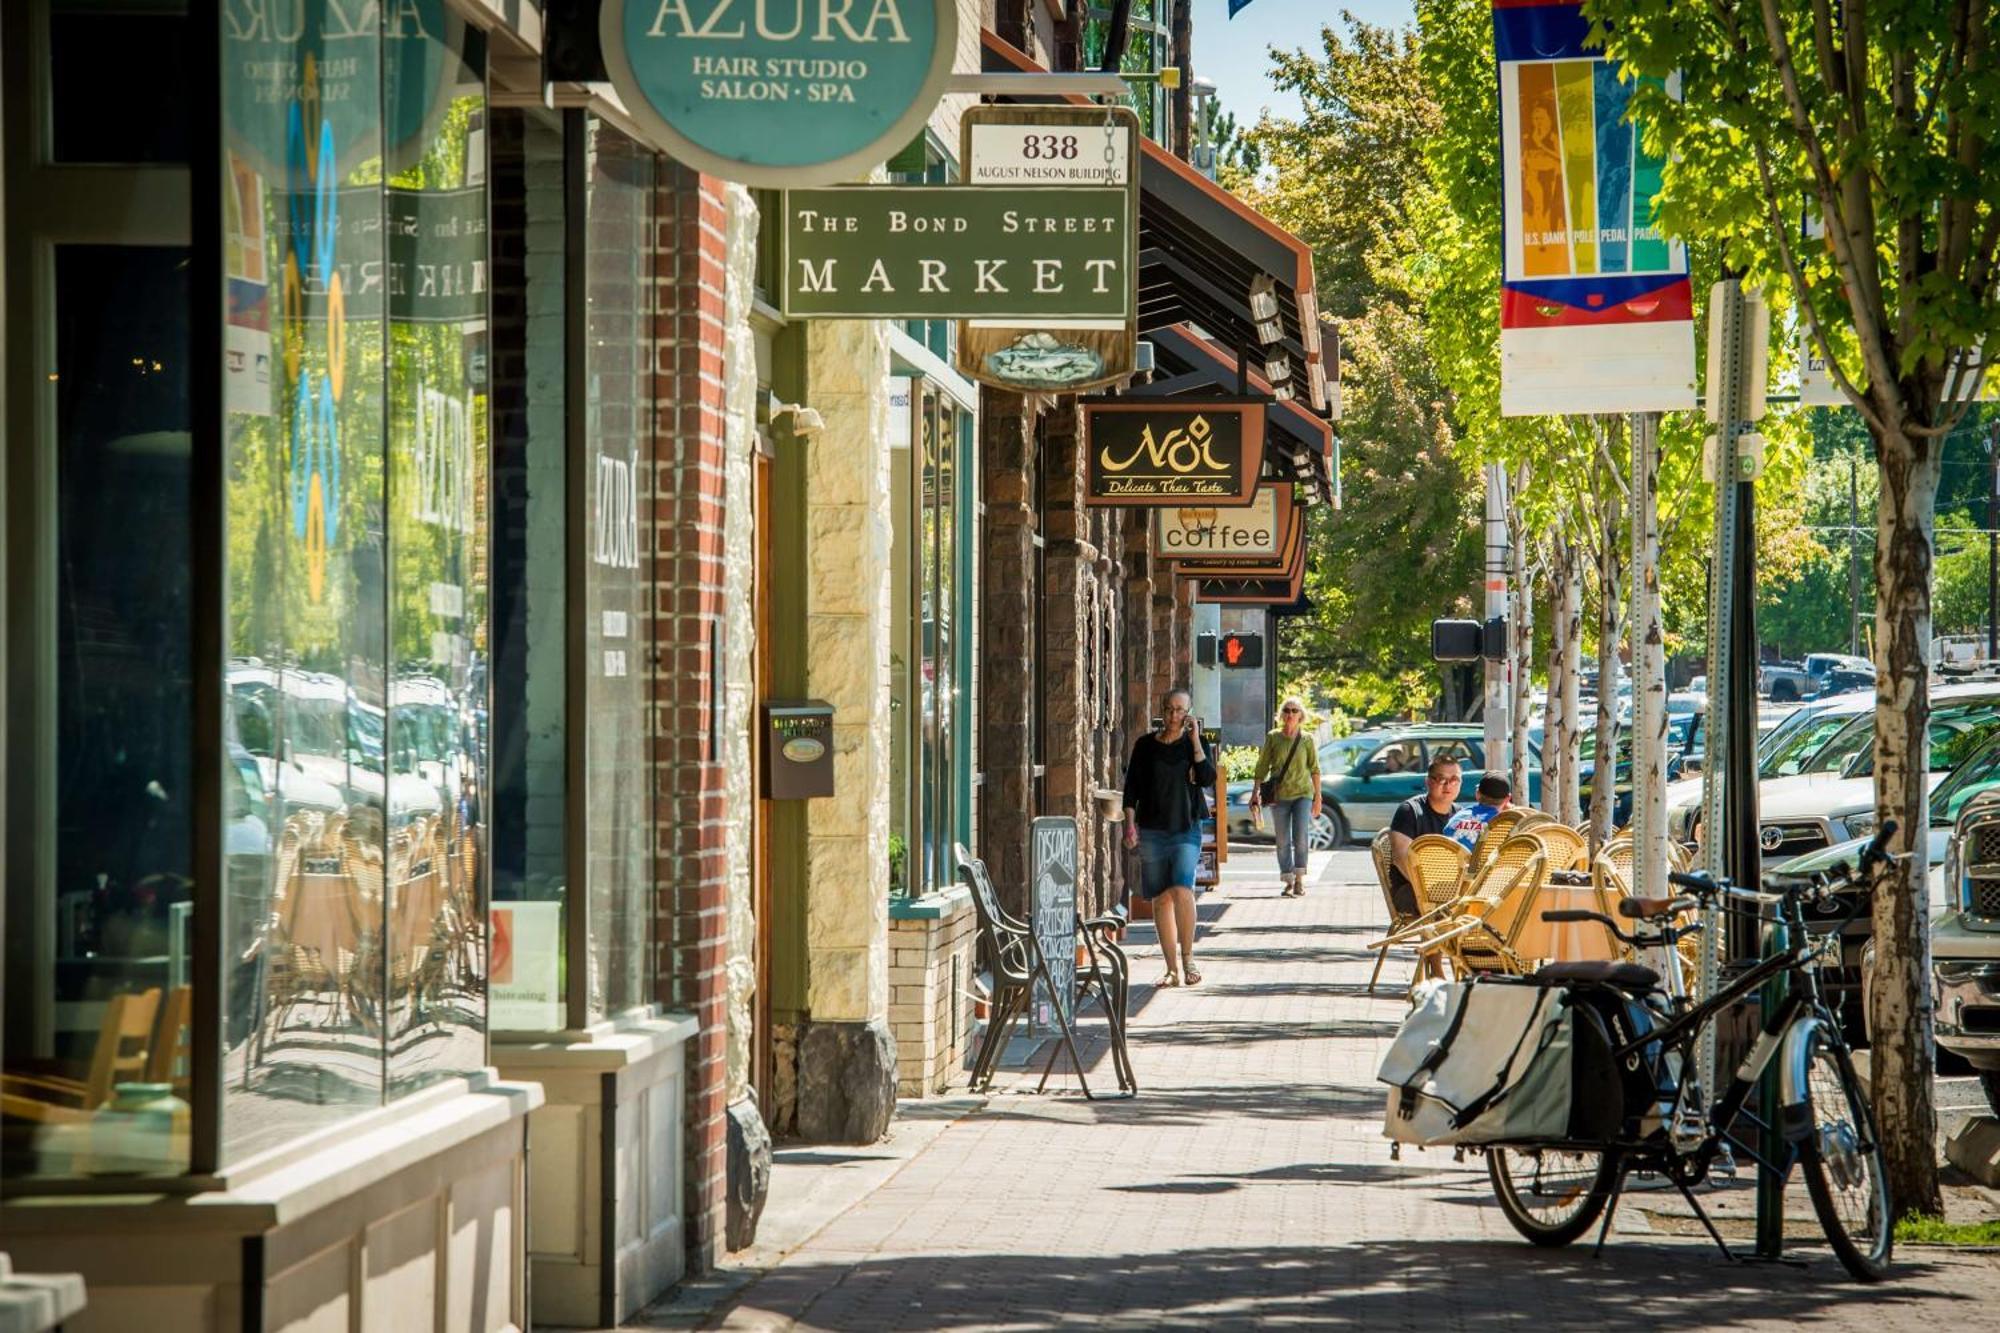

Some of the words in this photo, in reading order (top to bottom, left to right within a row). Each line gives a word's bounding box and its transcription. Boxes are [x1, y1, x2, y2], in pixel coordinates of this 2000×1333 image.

[646, 0, 911, 42] AZURA
[693, 57, 759, 77] HAIR
[766, 59, 868, 80] STUDIO
[701, 80, 789, 100] SALON
[808, 83, 856, 102] SPA
[1023, 135, 1078, 160] 838
[976, 167, 1021, 178] AUGUST
[1023, 167, 1066, 179] NELSON
[1542, 230, 1567, 245] BANK
[1601, 228, 1627, 242] PEDAL
[798, 259, 1117, 293] MARKET
[1109, 477, 1156, 493] Delicate
[1160, 476, 1190, 493] Thai
[1193, 480, 1223, 493] Taste
[1166, 525, 1270, 548] coffee
[1455, 820, 1483, 831] ALTA
